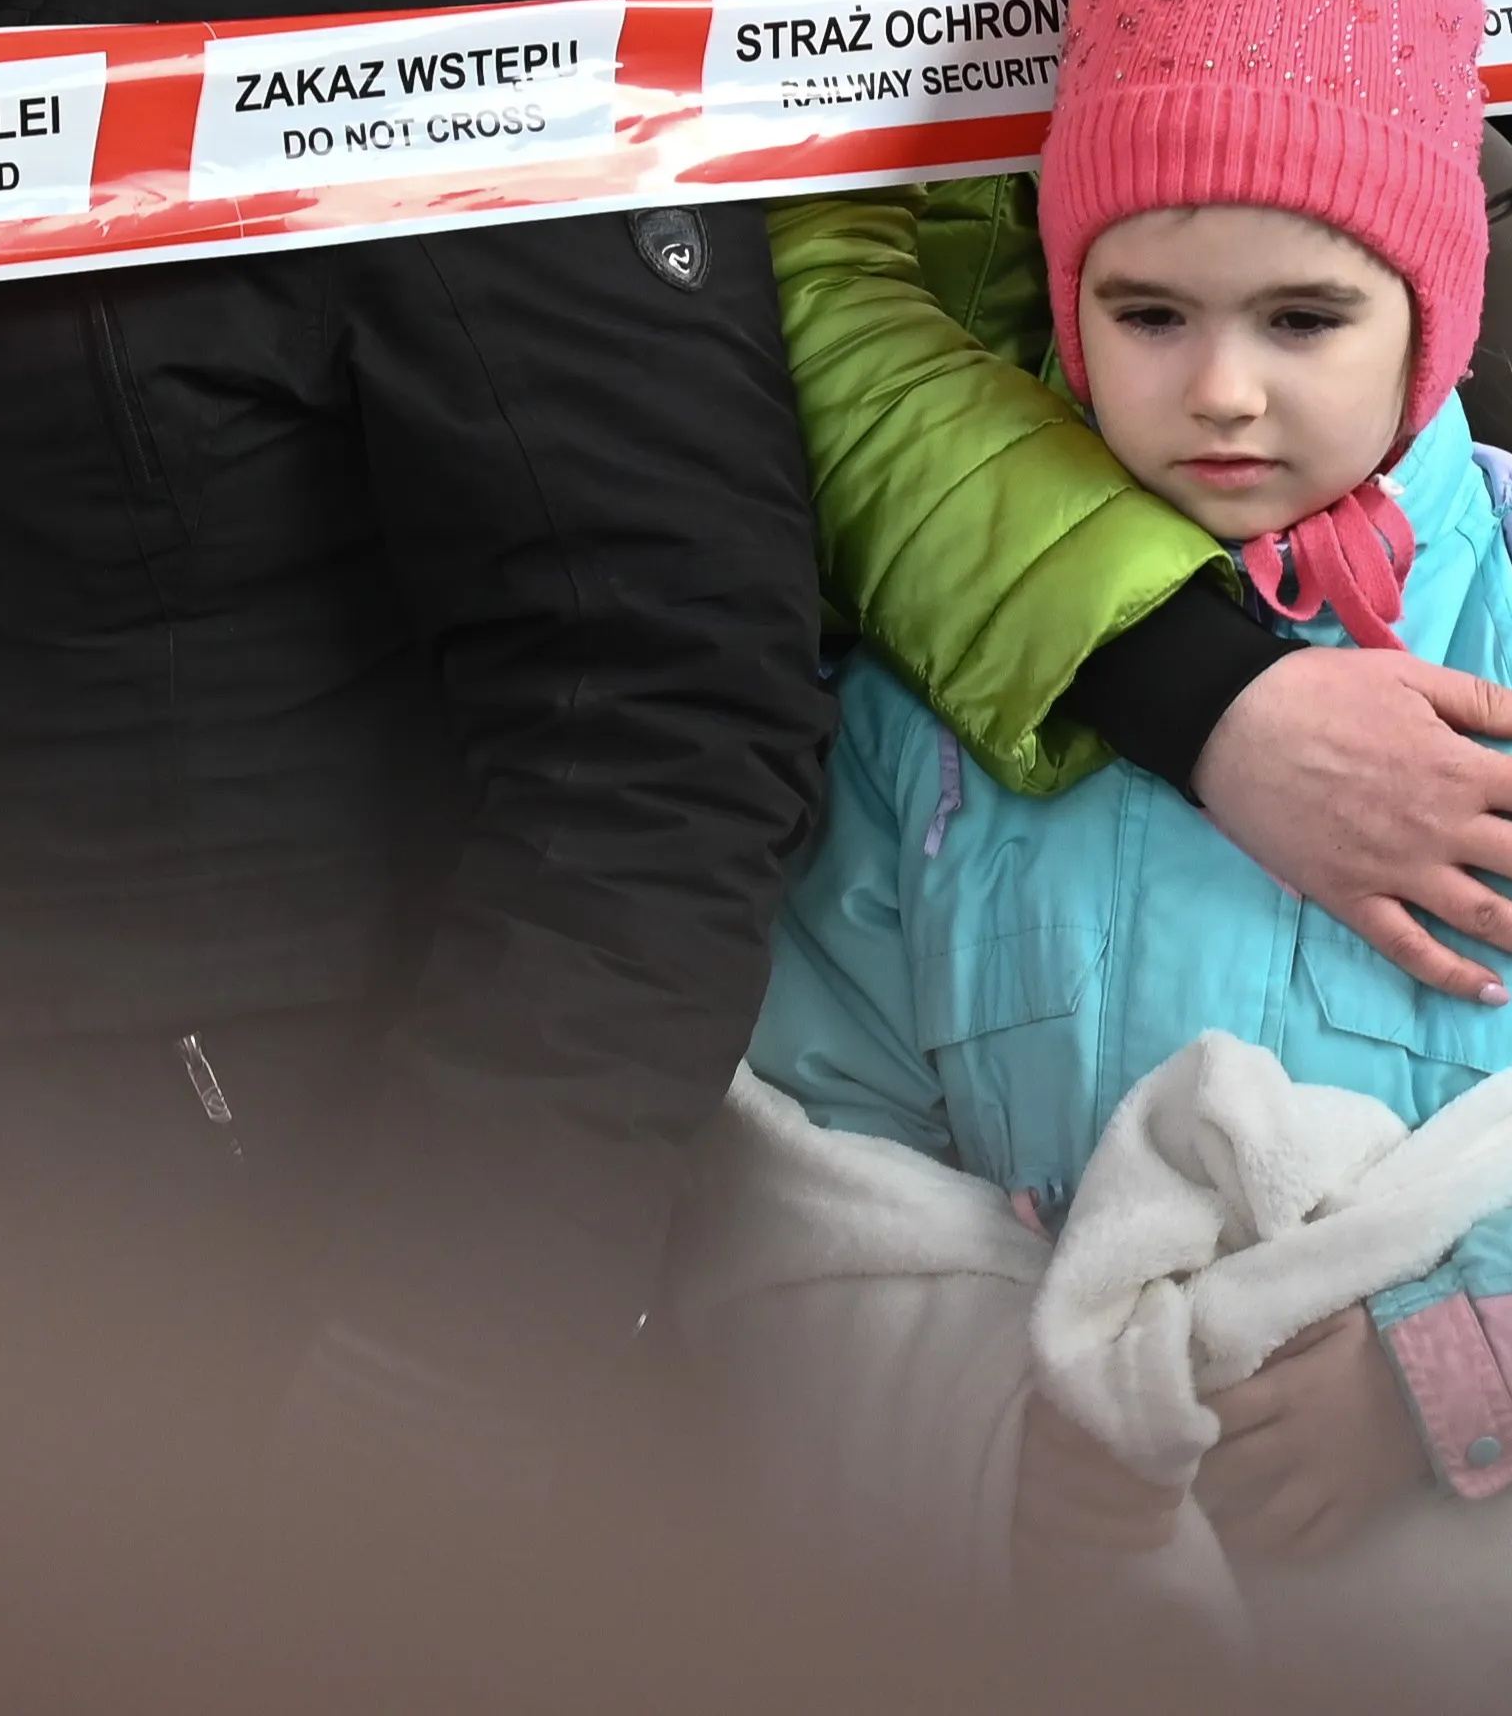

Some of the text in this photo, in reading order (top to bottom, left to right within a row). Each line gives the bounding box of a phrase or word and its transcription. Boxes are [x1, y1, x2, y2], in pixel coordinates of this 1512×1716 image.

[736, 4, 873, 63] STRAŻ
[234, 59, 386, 113] ZAKAZ
[781, 54, 1061, 109] RAILWAY SECURIT
[283, 103, 546, 160] DO NOT CROSS
